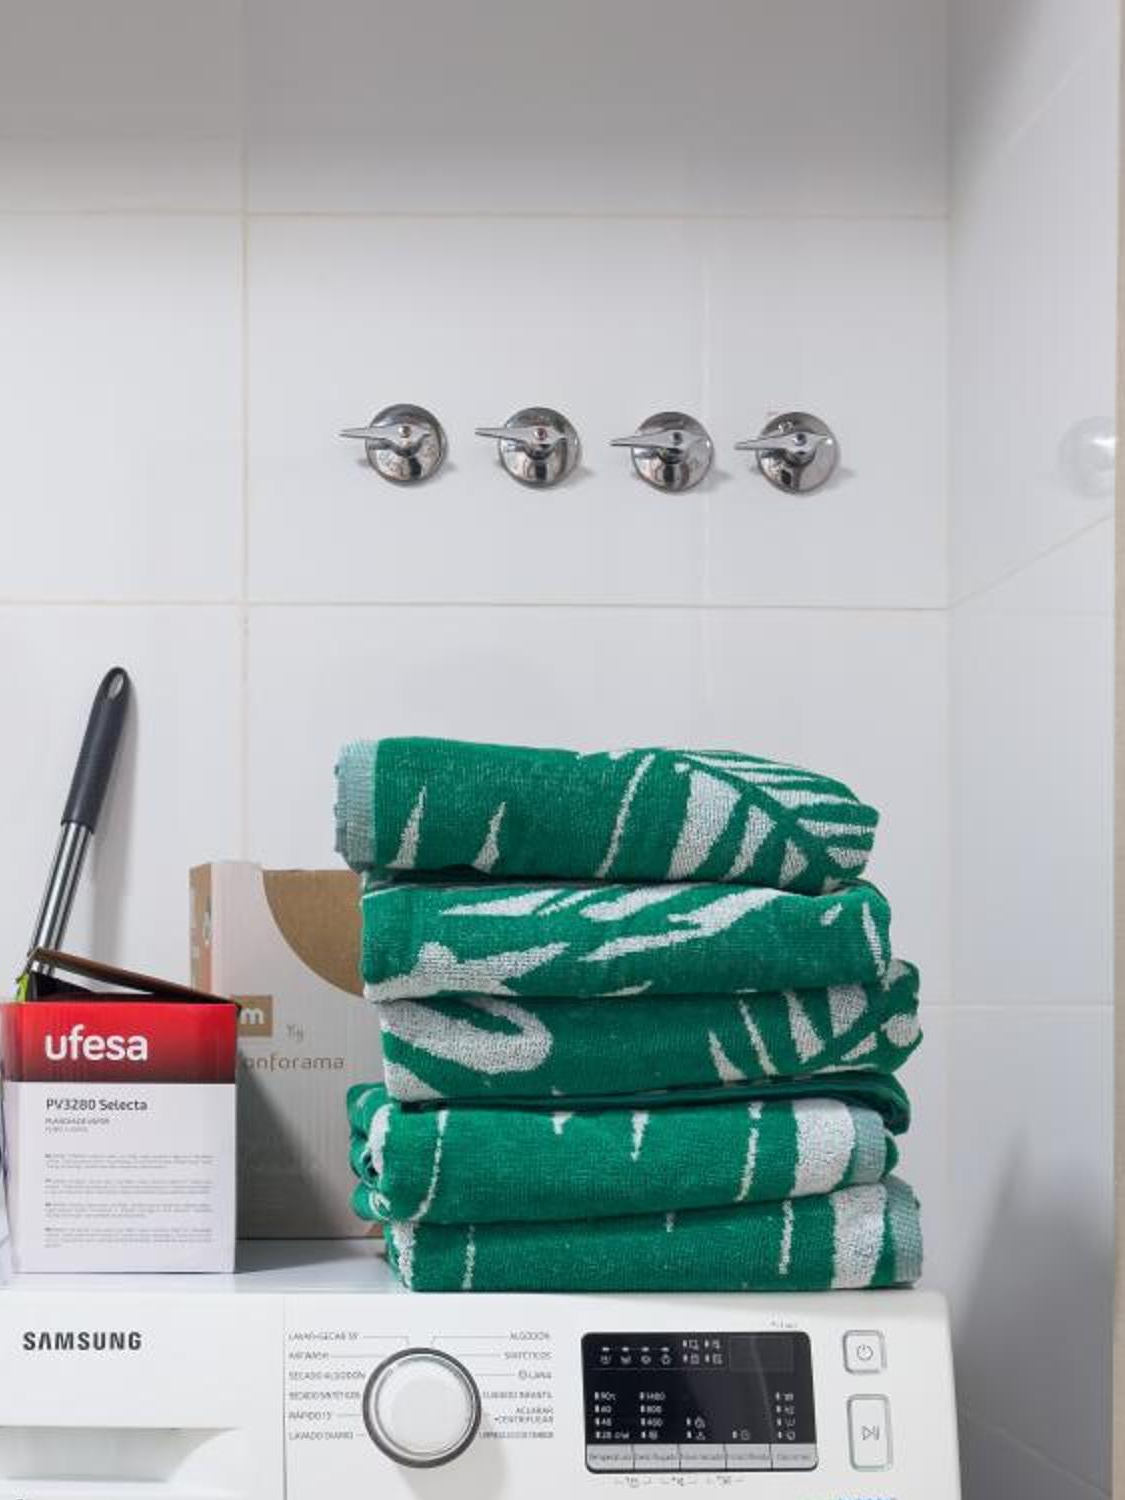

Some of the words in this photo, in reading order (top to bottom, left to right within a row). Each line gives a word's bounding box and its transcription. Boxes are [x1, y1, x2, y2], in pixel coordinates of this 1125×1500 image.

[44, 1025, 148, 1061] ufesa
[240, 1052, 345, 1072] onforama
[46, 1098, 96, 1112] PV3280
[99, 1098, 148, 1112] Selecta
[23, 1331, 143, 1351] SAMSUNG
